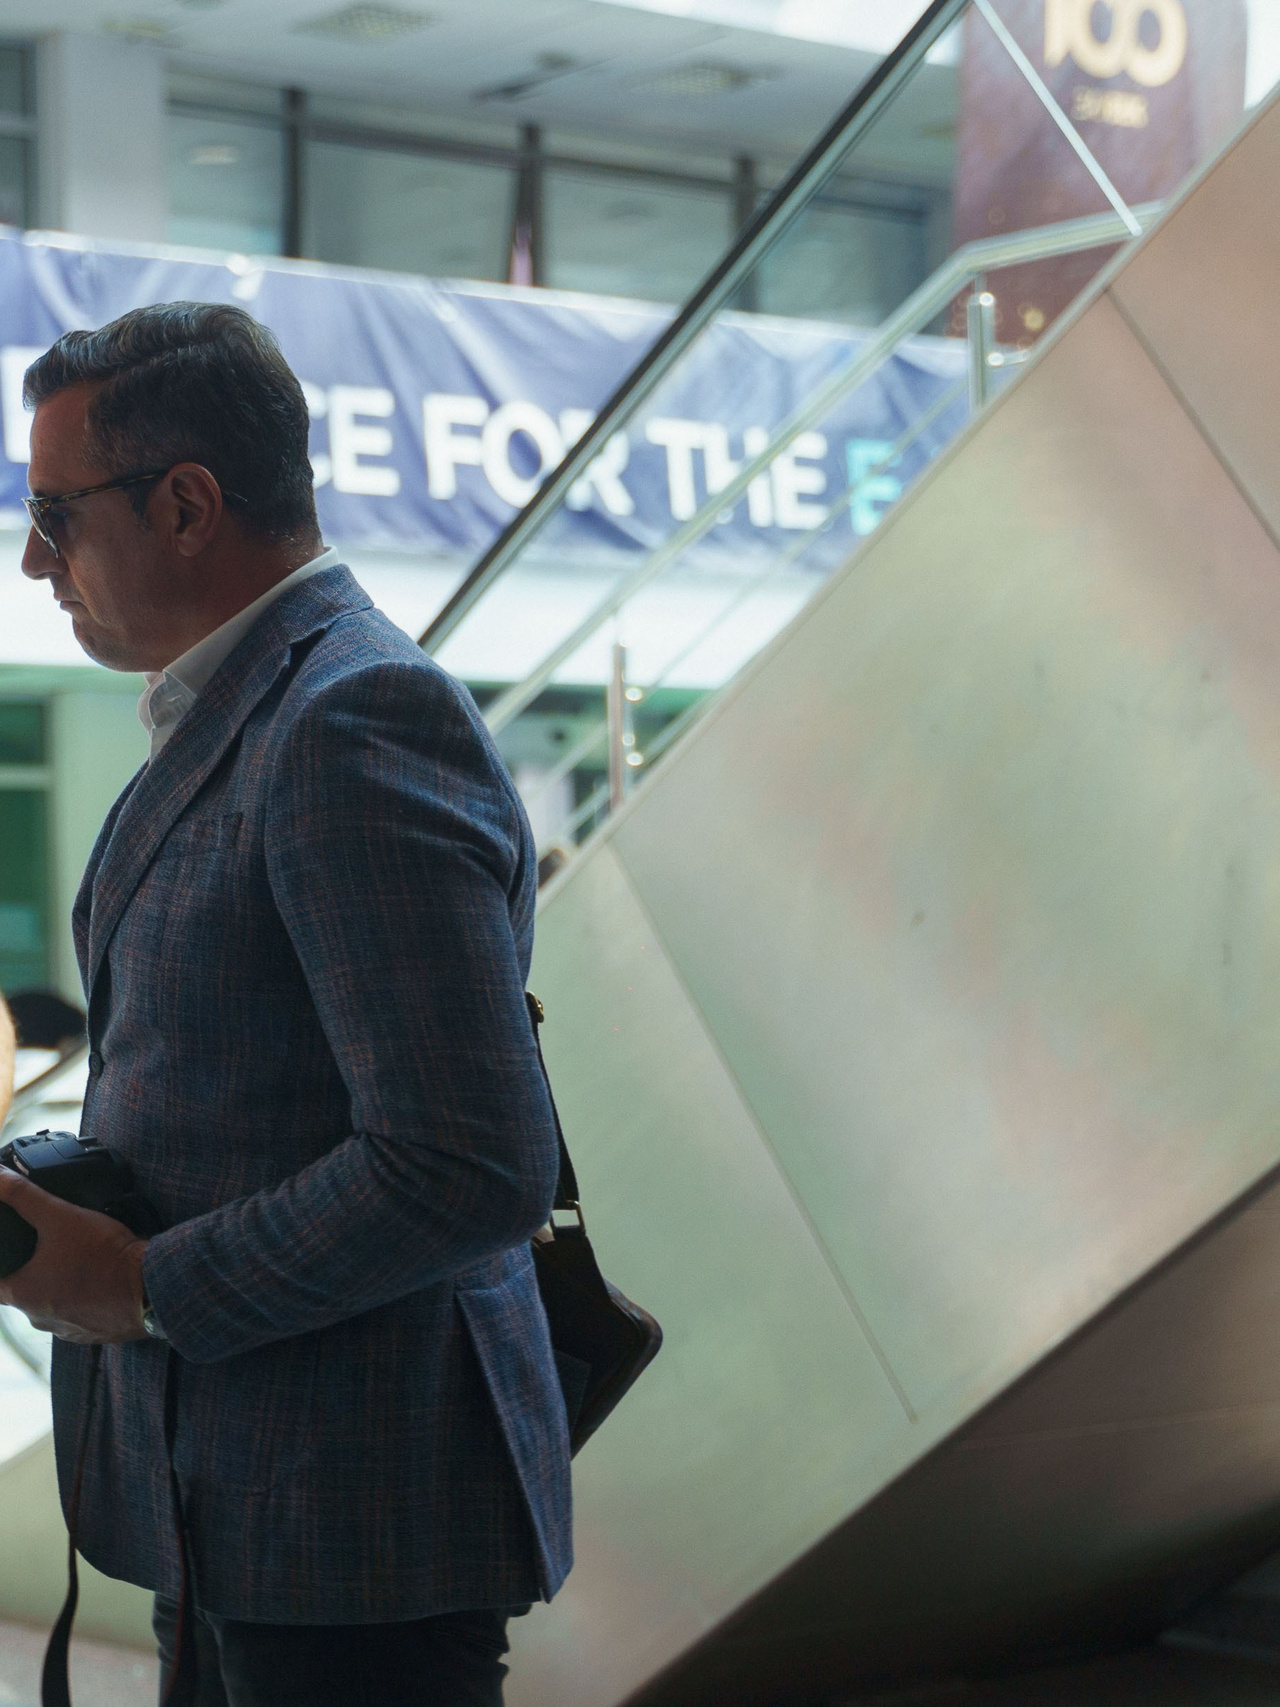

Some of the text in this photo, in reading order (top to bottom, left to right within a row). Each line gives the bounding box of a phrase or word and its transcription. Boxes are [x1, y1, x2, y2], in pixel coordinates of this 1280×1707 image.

[423, 392, 635, 516] FOR
[645, 417, 830, 530] THE
[846, 438, 910, 536] E
